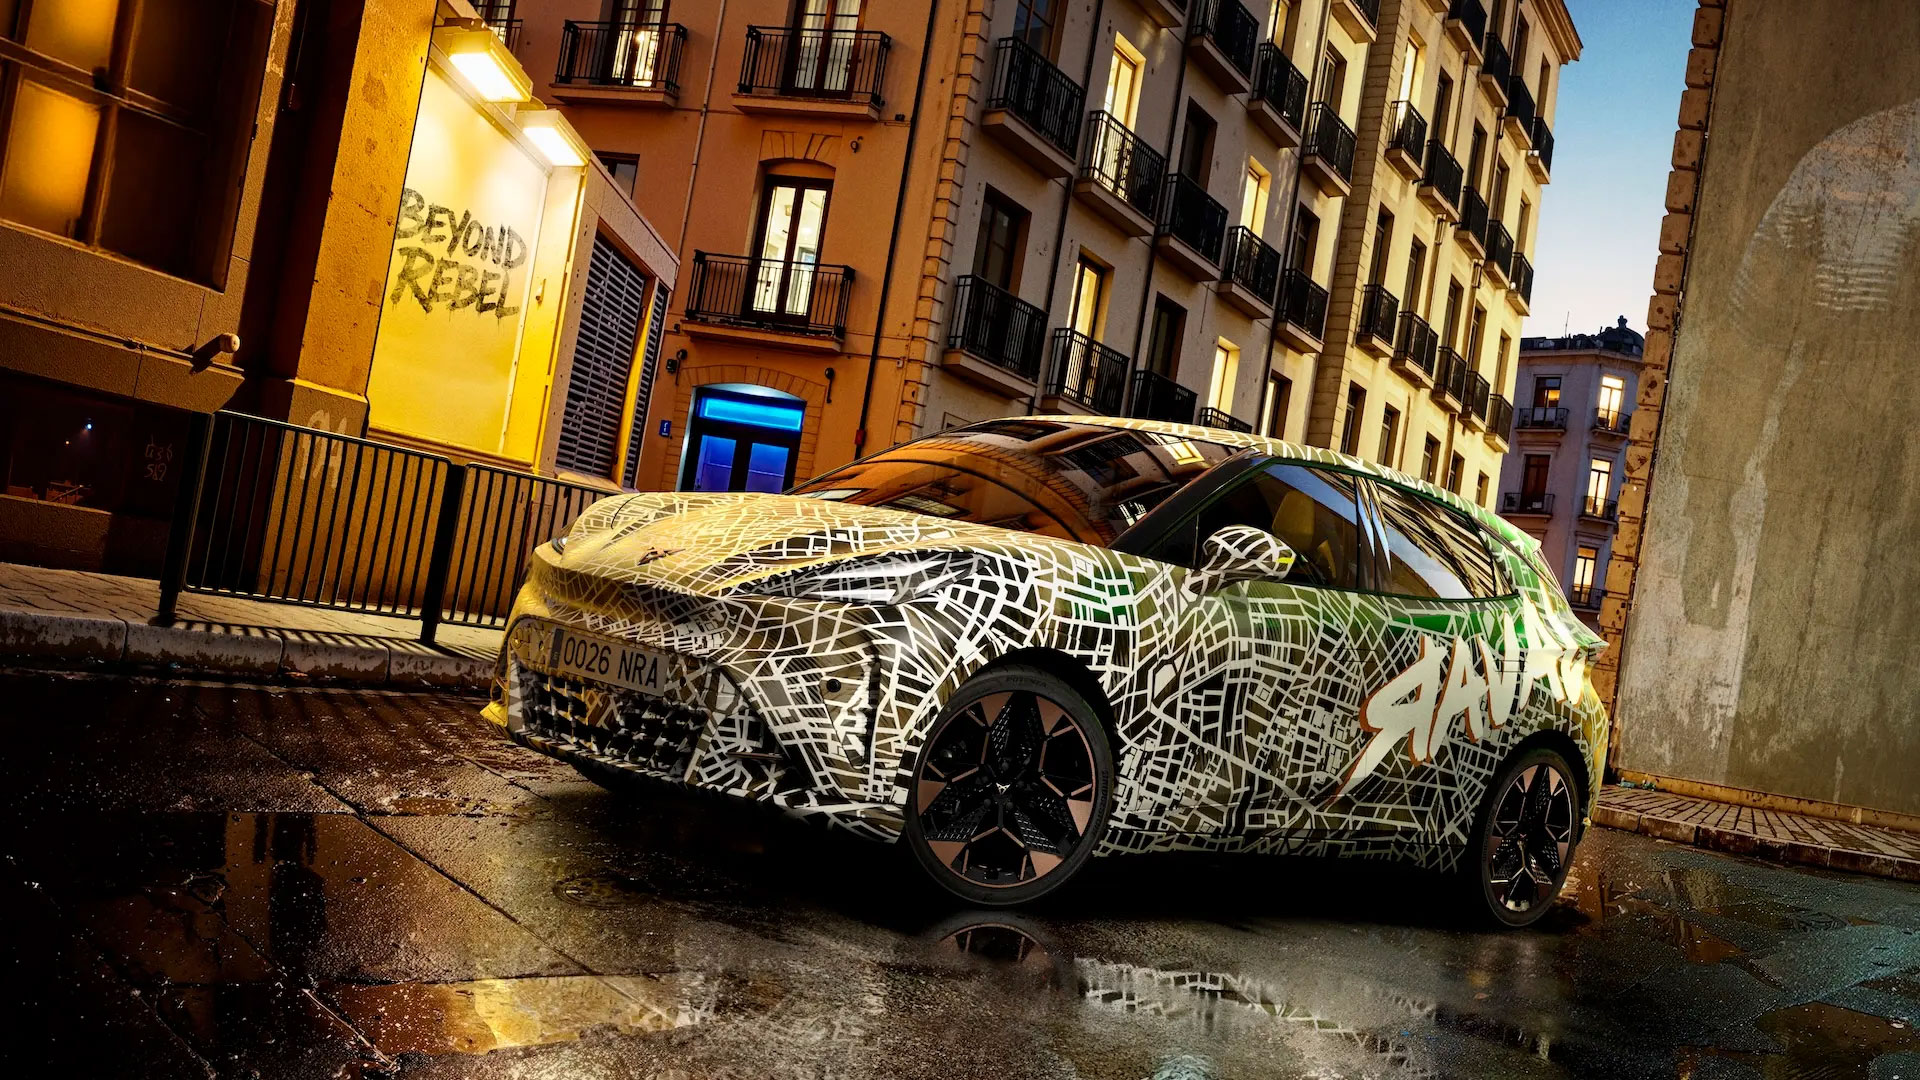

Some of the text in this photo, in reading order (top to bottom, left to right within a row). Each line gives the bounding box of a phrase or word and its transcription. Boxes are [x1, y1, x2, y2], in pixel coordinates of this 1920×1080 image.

[395, 187, 527, 270] BEYOND
[390, 246, 520, 320] REBEL
[563, 636, 658, 689] 0026 NRA
[1006, 674, 1048, 689] POTNZA
